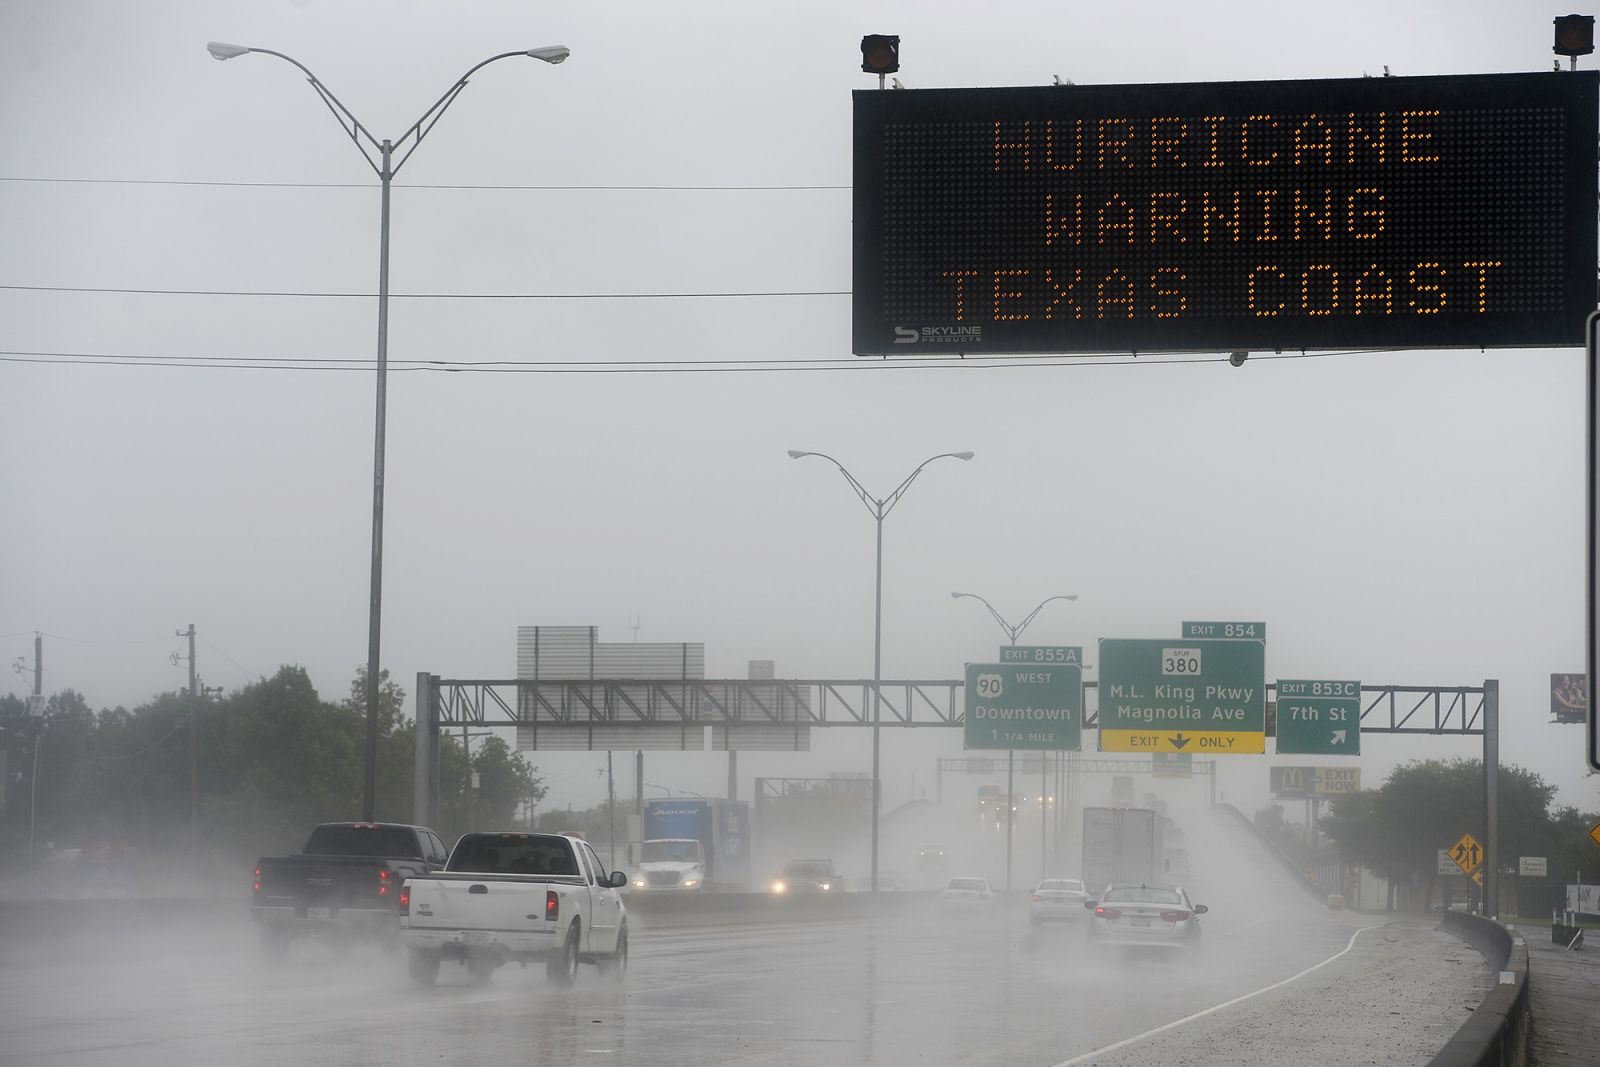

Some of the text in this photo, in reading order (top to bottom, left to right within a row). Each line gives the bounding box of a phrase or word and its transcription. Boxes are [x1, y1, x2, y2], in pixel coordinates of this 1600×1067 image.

[993, 109, 1442, 172] HURRICANE
[1044, 187, 1387, 245] WARNING
[942, 260, 1502, 322] TEXAS COAST
[921, 326, 982, 335] SKYLINE
[1190, 623, 1256, 638] EXIT 854
[1004, 648, 1077, 662] EXIT 855A
[1165, 658, 1199, 673] 380
[1015, 673, 1053, 684] WEST
[978, 679, 1001, 695] 90
[1110, 684, 1254, 703] M.L. King Pkwy
[1281, 681, 1355, 696] EXIT 853C
[975, 705, 1071, 721] Downtown
[1117, 705, 1245, 723] Magnolia Ave
[1290, 706, 1347, 721] 7th St
[990, 729, 1055, 742] 1 1/4 MILE
[1130, 735, 1235, 748] EXIT ONLY
[1326, 769, 1356, 780] EXIT
